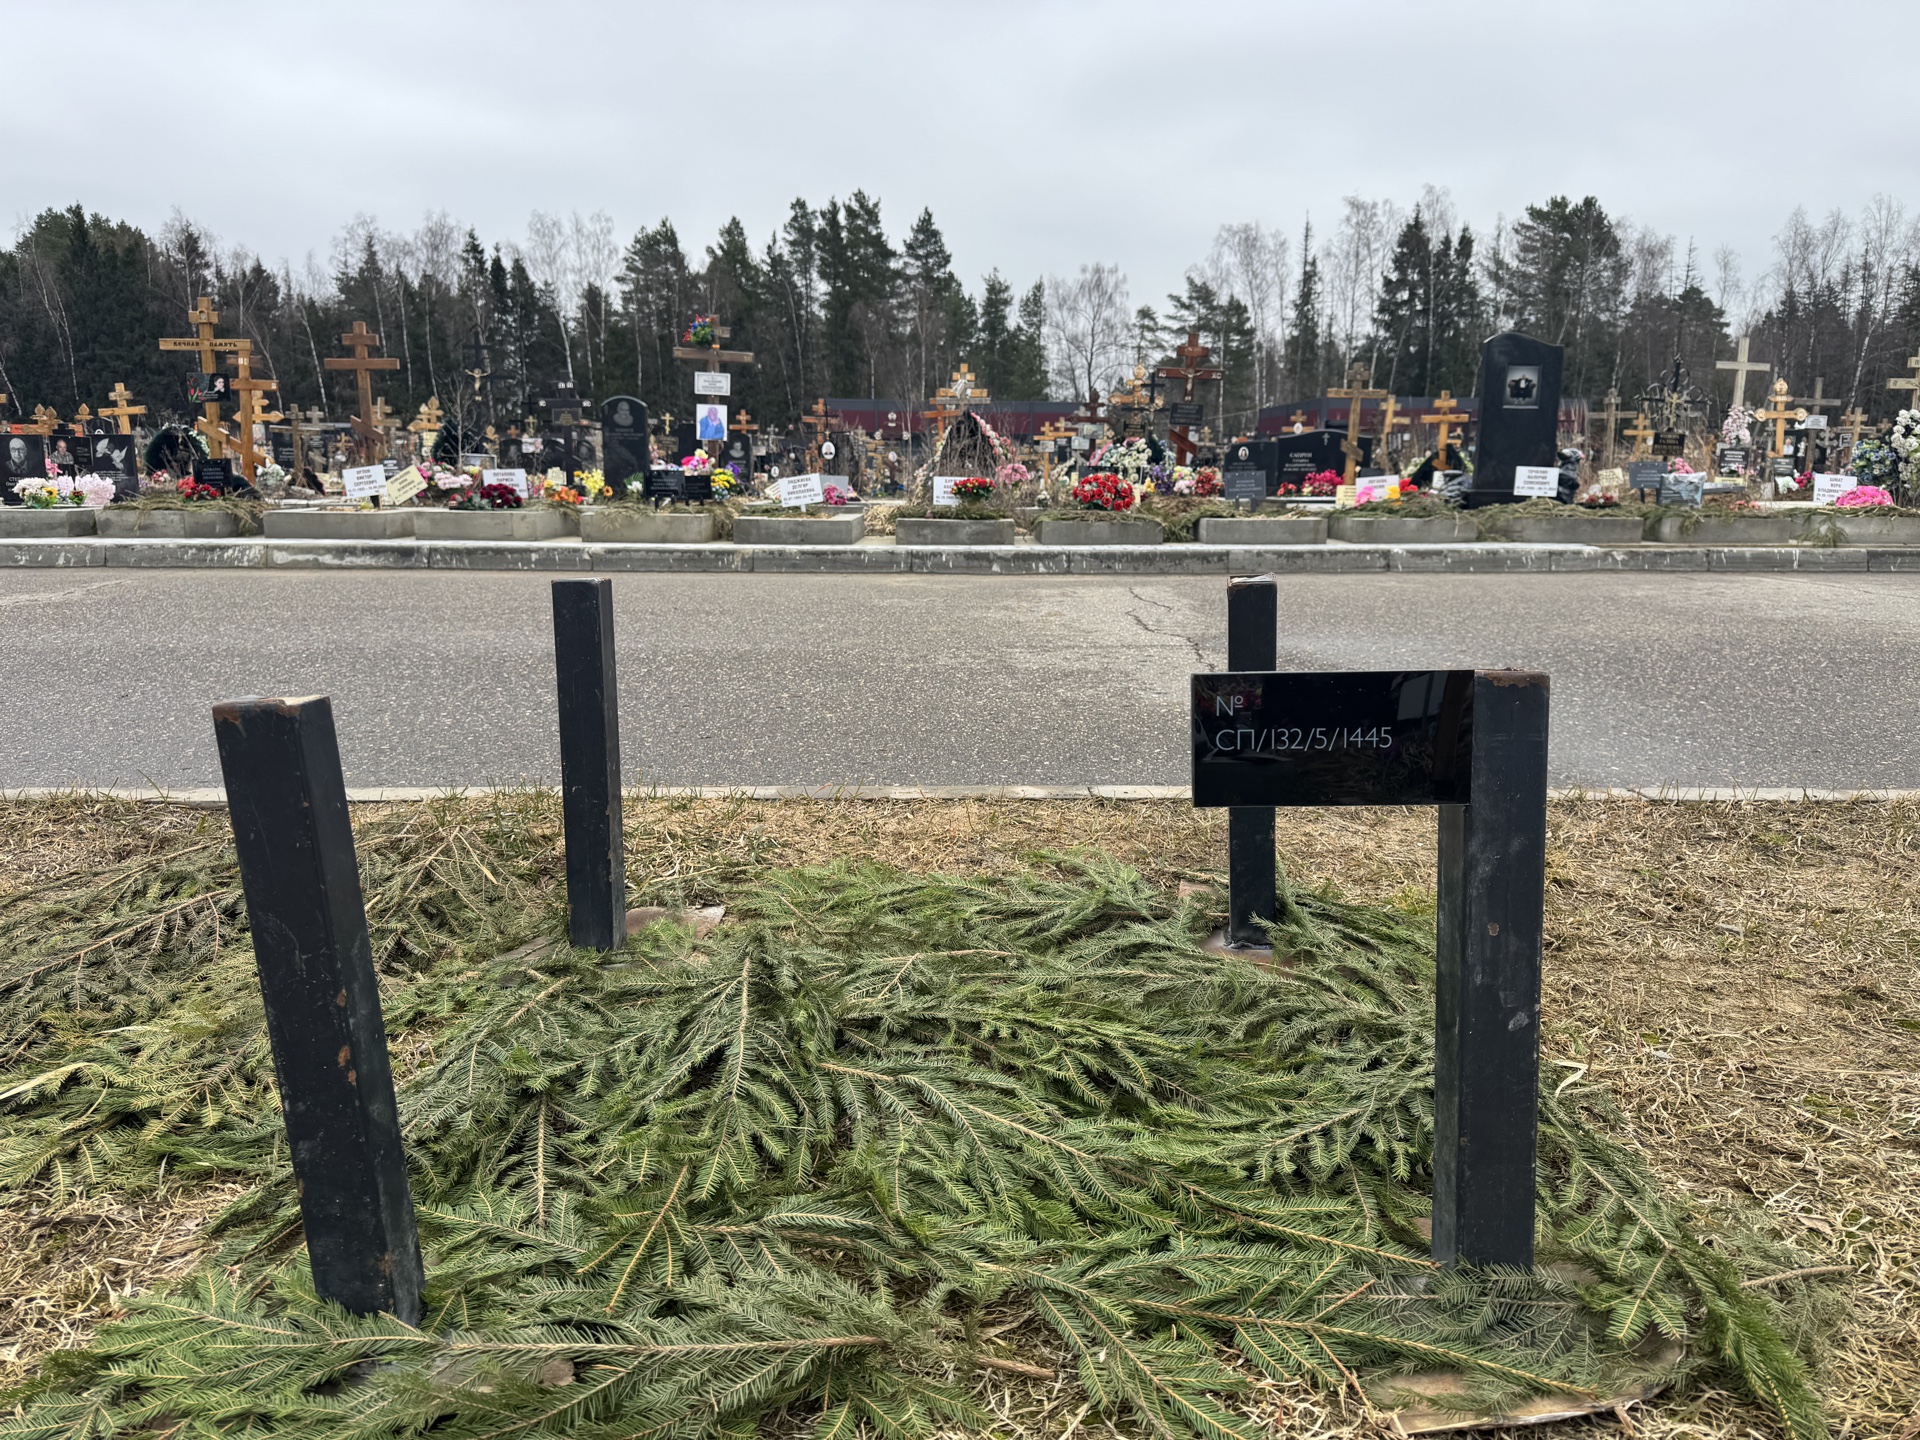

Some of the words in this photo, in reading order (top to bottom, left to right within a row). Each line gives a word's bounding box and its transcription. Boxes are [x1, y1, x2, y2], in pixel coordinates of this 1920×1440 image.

[353, 479, 378, 487] СЕРГЕЕВИЧ
[787, 488, 815, 496] НИКОЛАЕВНА
[1216, 695, 1244, 717] №
[1216, 727, 1393, 752] СП/132/5/1445
